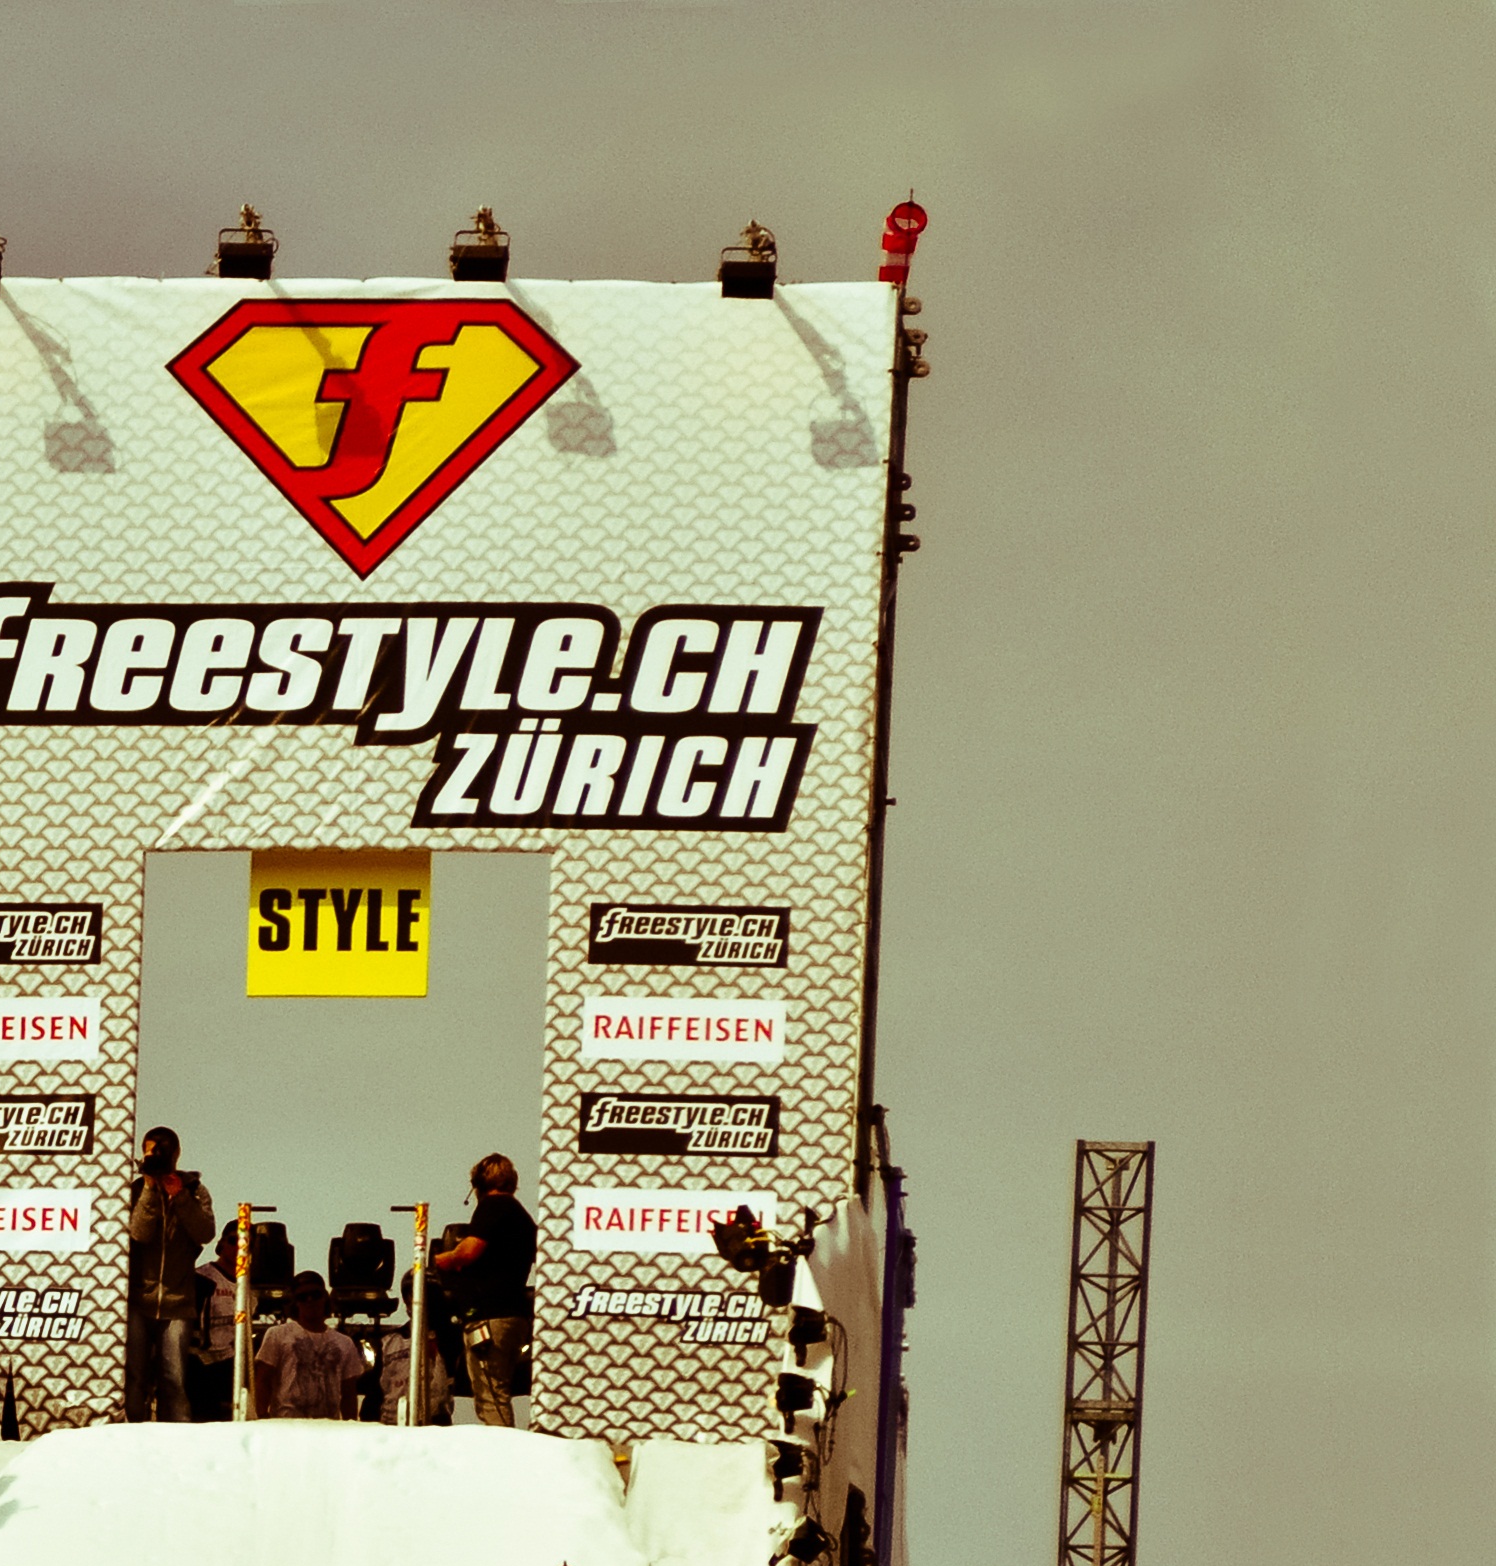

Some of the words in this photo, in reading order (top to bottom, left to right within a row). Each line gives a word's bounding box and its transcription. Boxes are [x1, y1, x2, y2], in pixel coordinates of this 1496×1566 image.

[433, 720, 797, 821] ZÜRICH
[258, 887, 422, 952] STYLE
[14, 935, 92, 958] ZÜRICH
[700, 938, 779, 961] ZÜRICH
[593, 1014, 774, 1042] RAIFFEISEN
[8, 1126, 85, 1147] ZÜRICH
[691, 1128, 770, 1149] ZÜRICH
[682, 1317, 769, 1343] ZÜRICH
